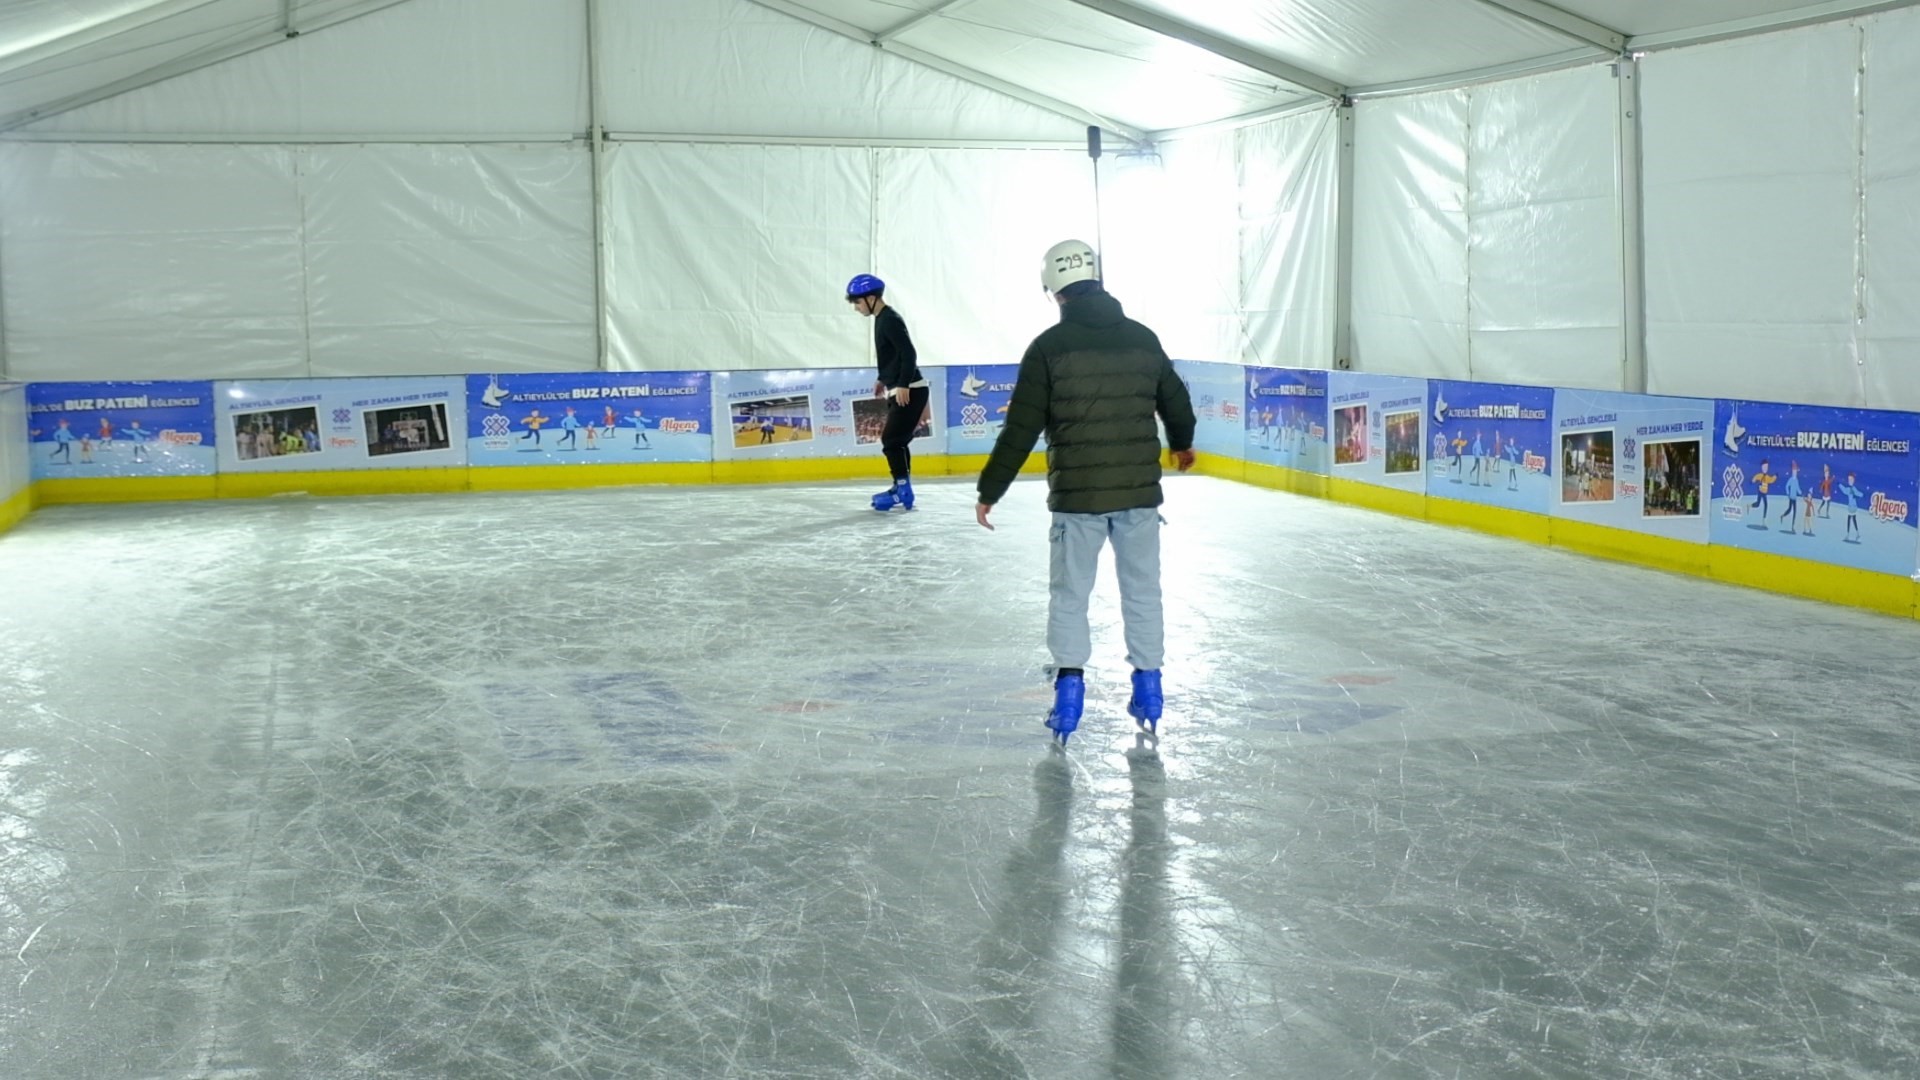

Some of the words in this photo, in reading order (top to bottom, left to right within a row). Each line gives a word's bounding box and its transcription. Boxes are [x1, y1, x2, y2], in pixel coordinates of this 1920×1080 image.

[1064, 253, 1083, 269] 29
[512, 390, 571, 402] ALTIEYLÜL'DE
[572, 387, 600, 399] BUZ
[601, 383, 650, 398] PATENİ
[652, 385, 699, 396] EĞLENCESİ
[64, 399, 95, 411] BUZ
[96, 395, 148, 409] PATENİ
[1479, 404, 1493, 418] BUZ
[1494, 402, 1520, 419] PATENİ
[1637, 426, 1648, 436] HER
[1649, 424, 1670, 434] ZAMAN
[1670, 423, 1683, 433] HER
[1684, 421, 1704, 431] YERDE
[1747, 433, 1796, 447] ALTIEYLÜL'DE
[1797, 431, 1819, 449] BUZ
[1821, 430, 1865, 451] PATENİ
[1866, 438, 1910, 453] EĞLENCESİ
[1871, 492, 1907, 520] Algenç
